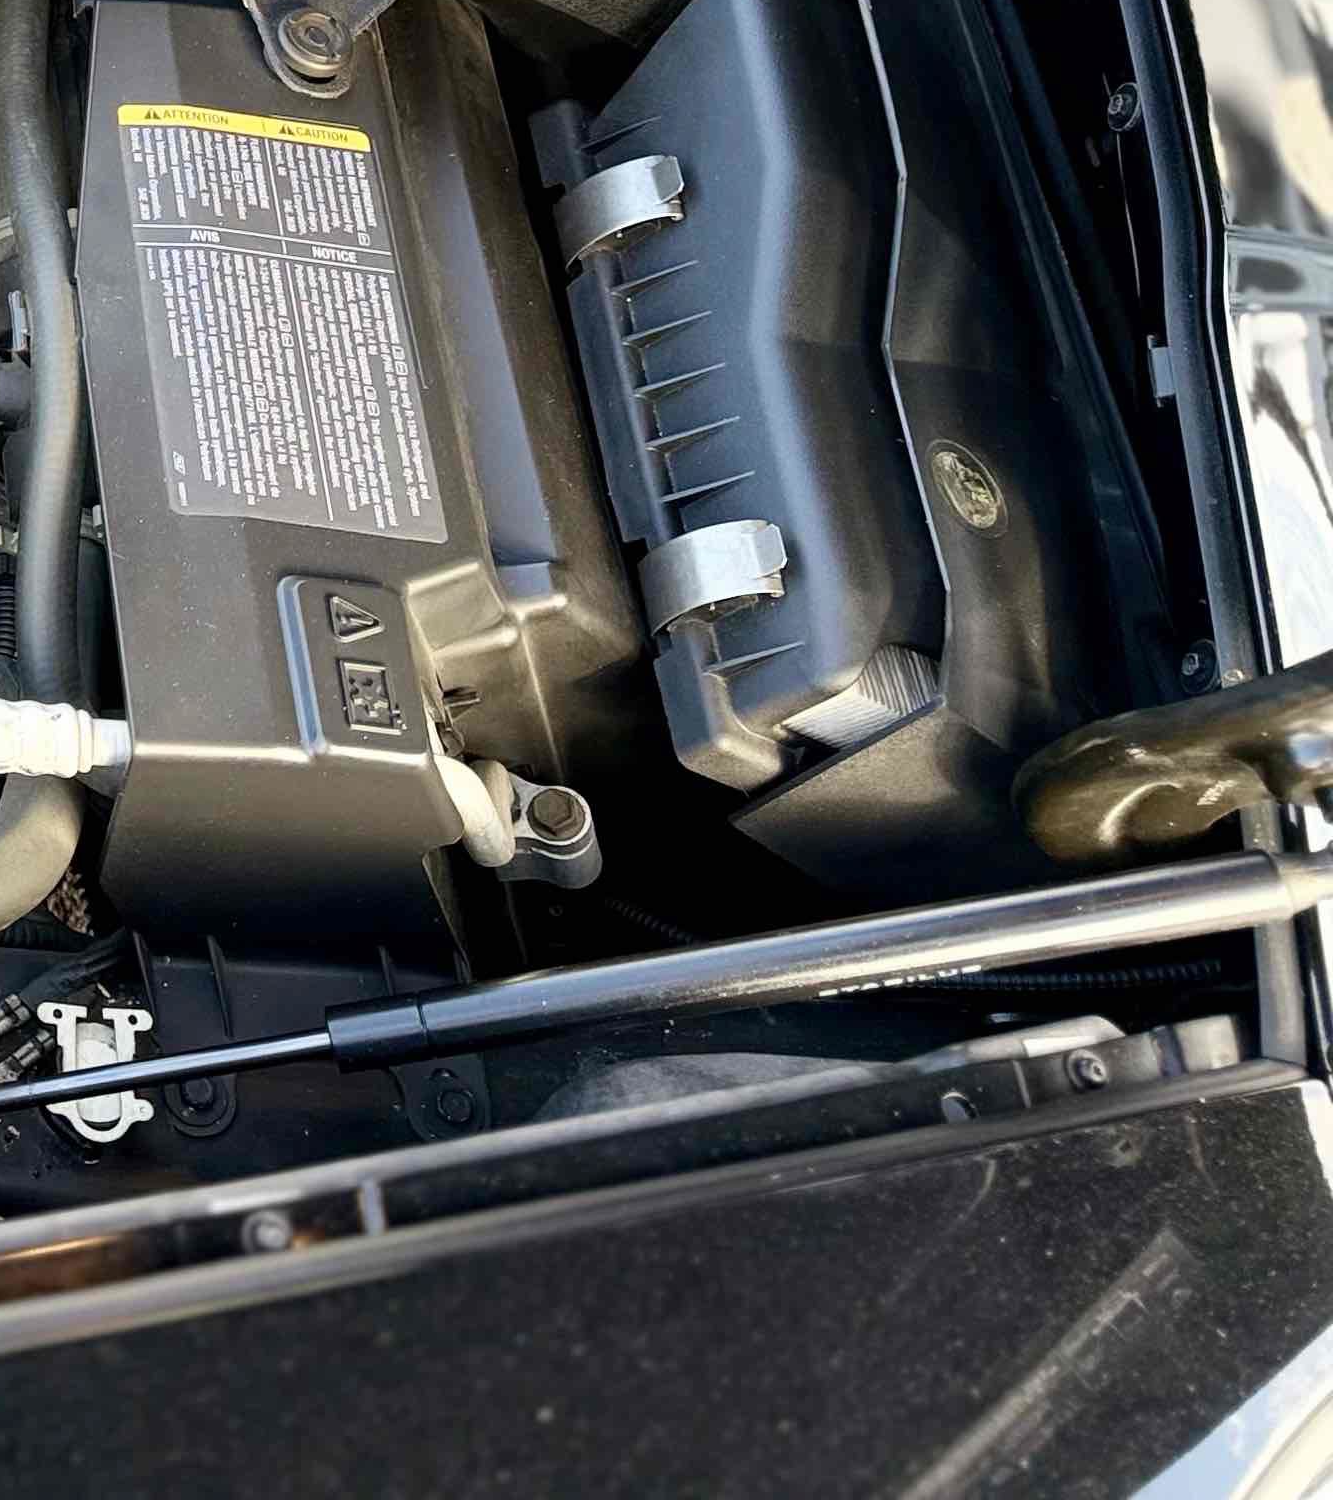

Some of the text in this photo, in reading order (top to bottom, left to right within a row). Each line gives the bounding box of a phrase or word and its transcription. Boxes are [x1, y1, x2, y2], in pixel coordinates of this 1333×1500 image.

[163, 110, 229, 126] ATTENTION
[296, 127, 349, 143] CAUTION
[190, 229, 221, 244] AVIS
[312, 246, 358, 264] NOTICE
